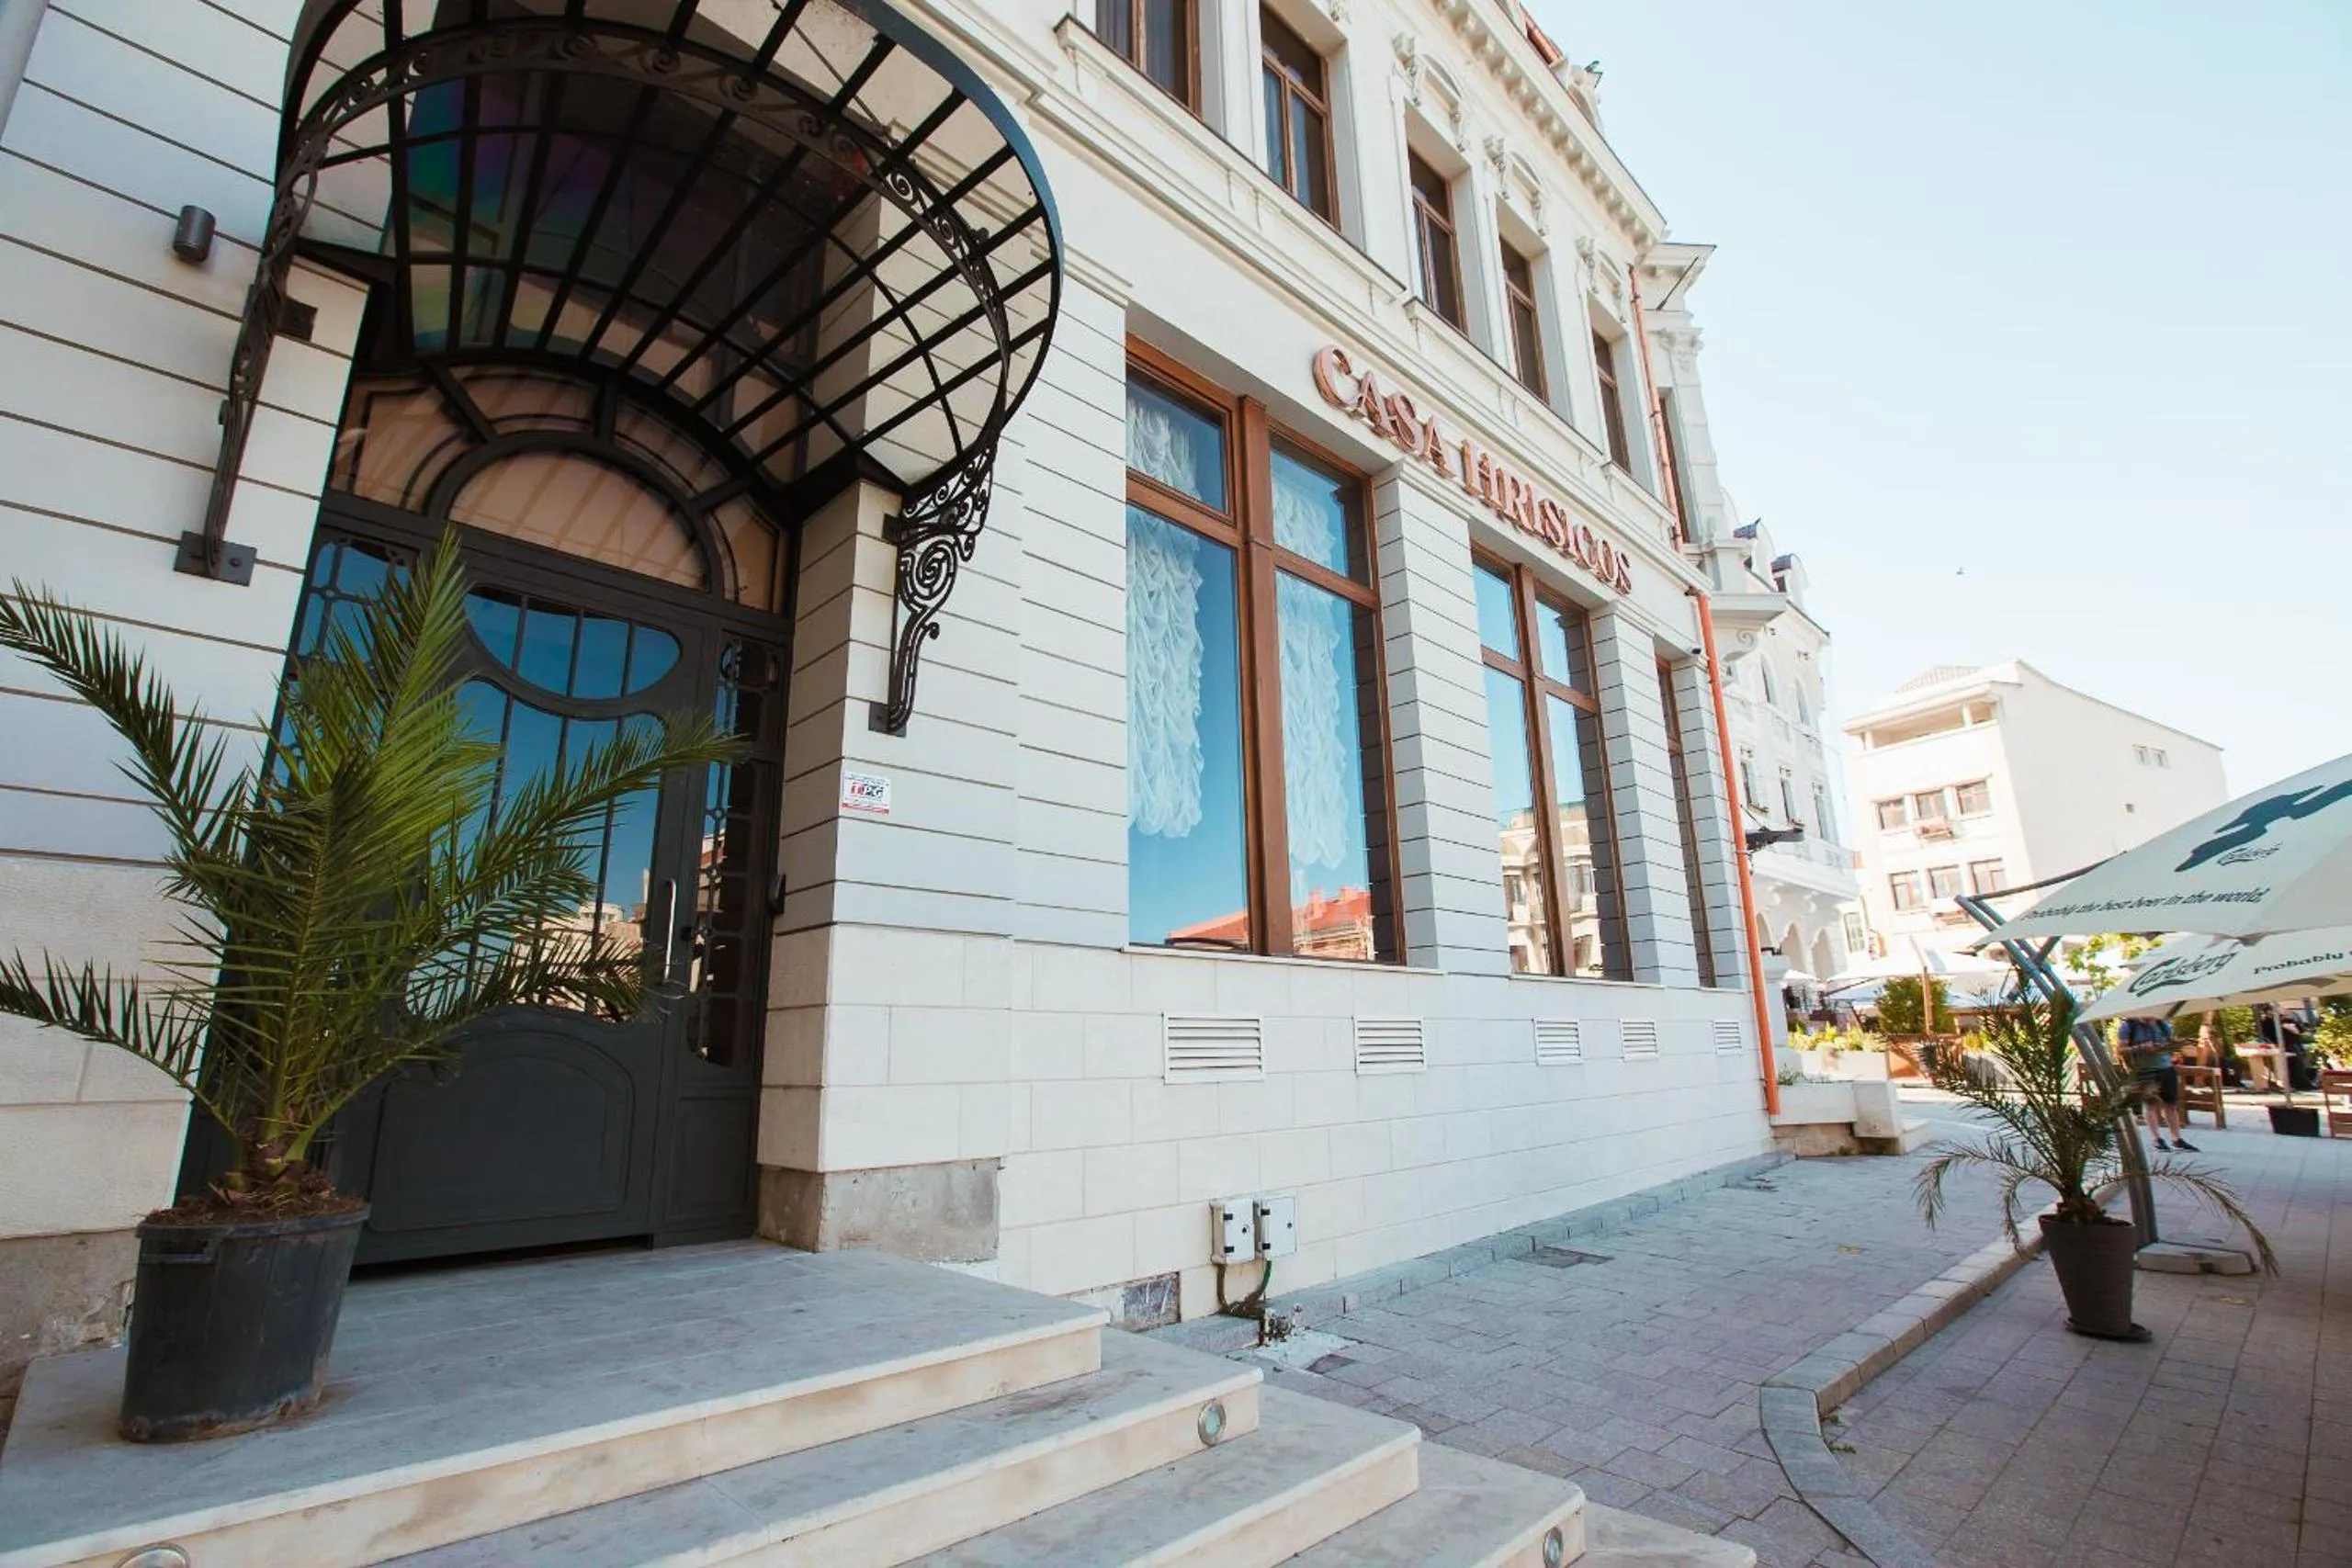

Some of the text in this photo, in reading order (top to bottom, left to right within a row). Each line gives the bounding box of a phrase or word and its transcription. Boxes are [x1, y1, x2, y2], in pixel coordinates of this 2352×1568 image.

[1312, 344, 1633, 595] CASA HRISICOS
[2254, 953, 2344, 975] Probably
